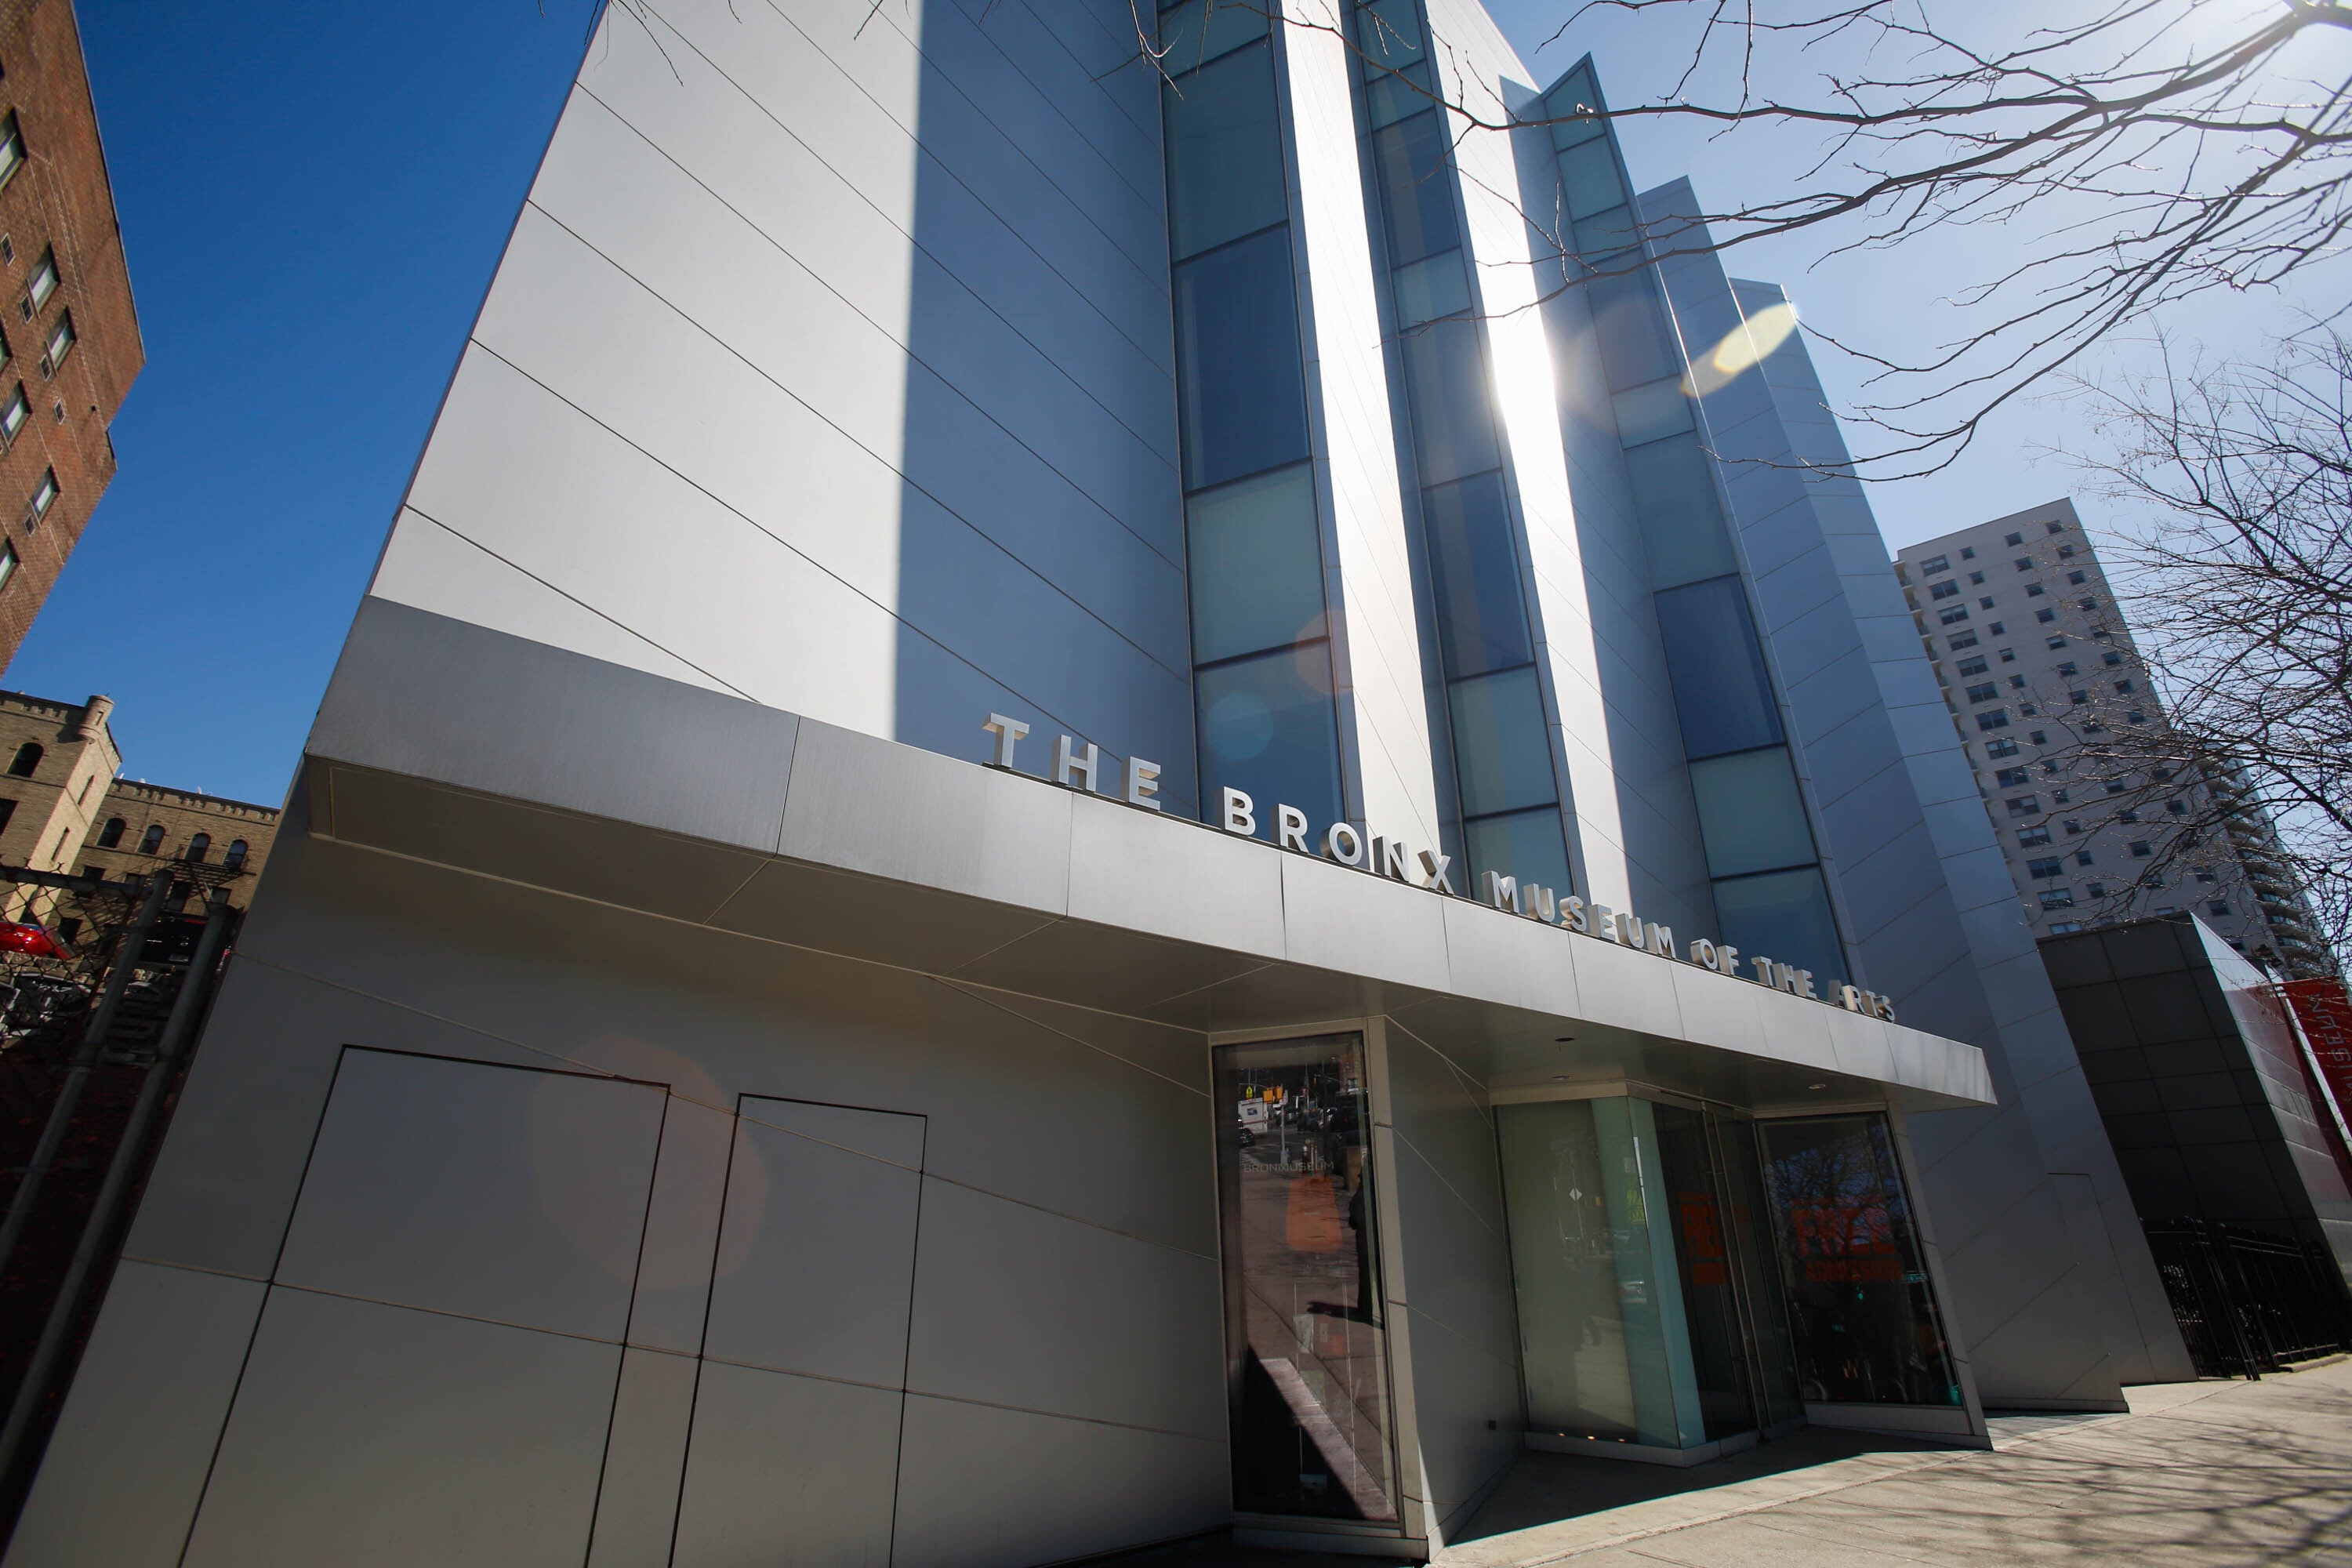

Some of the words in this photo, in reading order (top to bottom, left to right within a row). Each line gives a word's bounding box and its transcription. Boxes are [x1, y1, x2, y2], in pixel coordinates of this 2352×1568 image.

[982, 713, 1160, 811] THE
[1220, 786, 1454, 895] BRONX
[1482, 870, 1676, 958] MUSEUM
[1691, 938, 1740, 975] OF
[1751, 956, 1817, 999] THE
[1828, 979, 1895, 1022] ARTS
[1792, 1208, 1897, 1256] FREE
